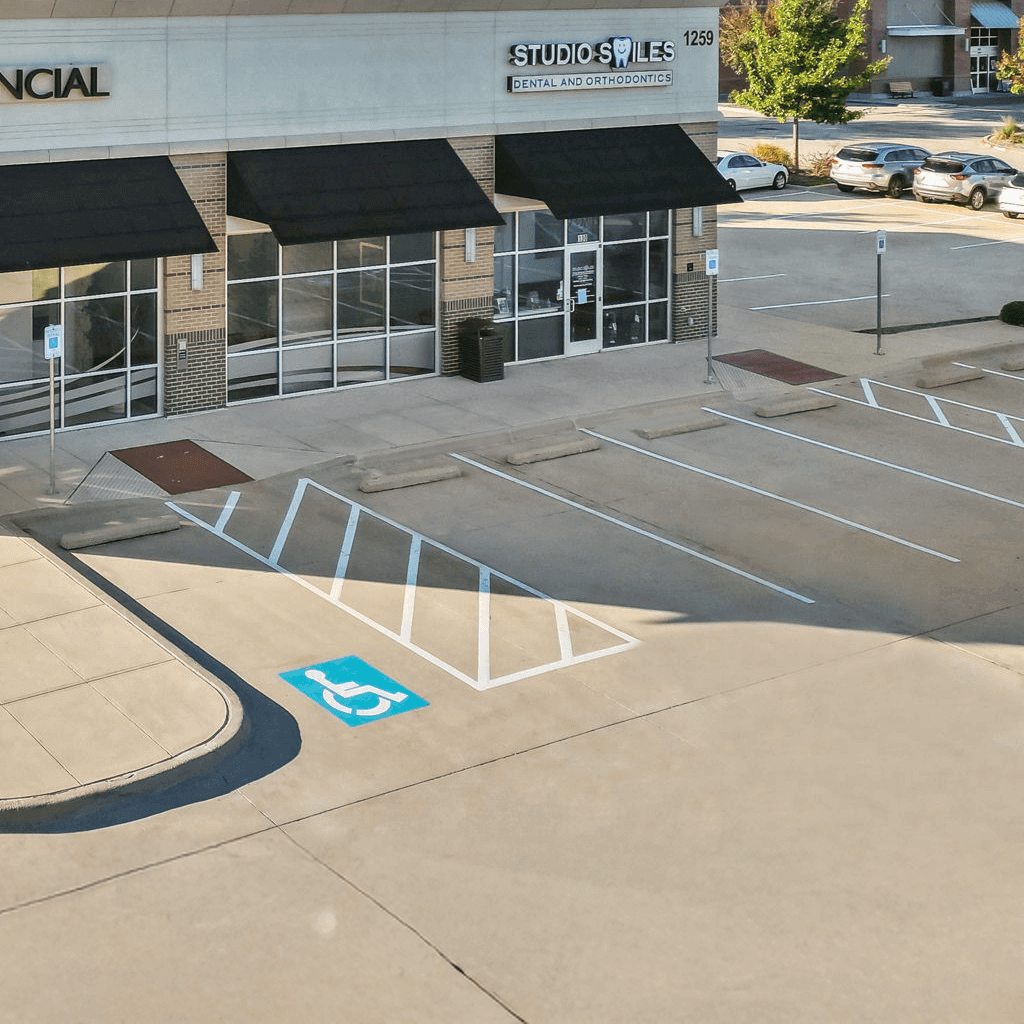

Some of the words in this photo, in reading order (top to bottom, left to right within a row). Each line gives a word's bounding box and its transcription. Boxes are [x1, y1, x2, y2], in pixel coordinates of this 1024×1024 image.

[683, 30, 714, 46] 1259
[511, 42, 593, 67] STUDIO
[513, 78, 557, 89] DENTAL
[560, 77, 583, 87] AND
[585, 74, 671, 86] ORTHODONTICS
